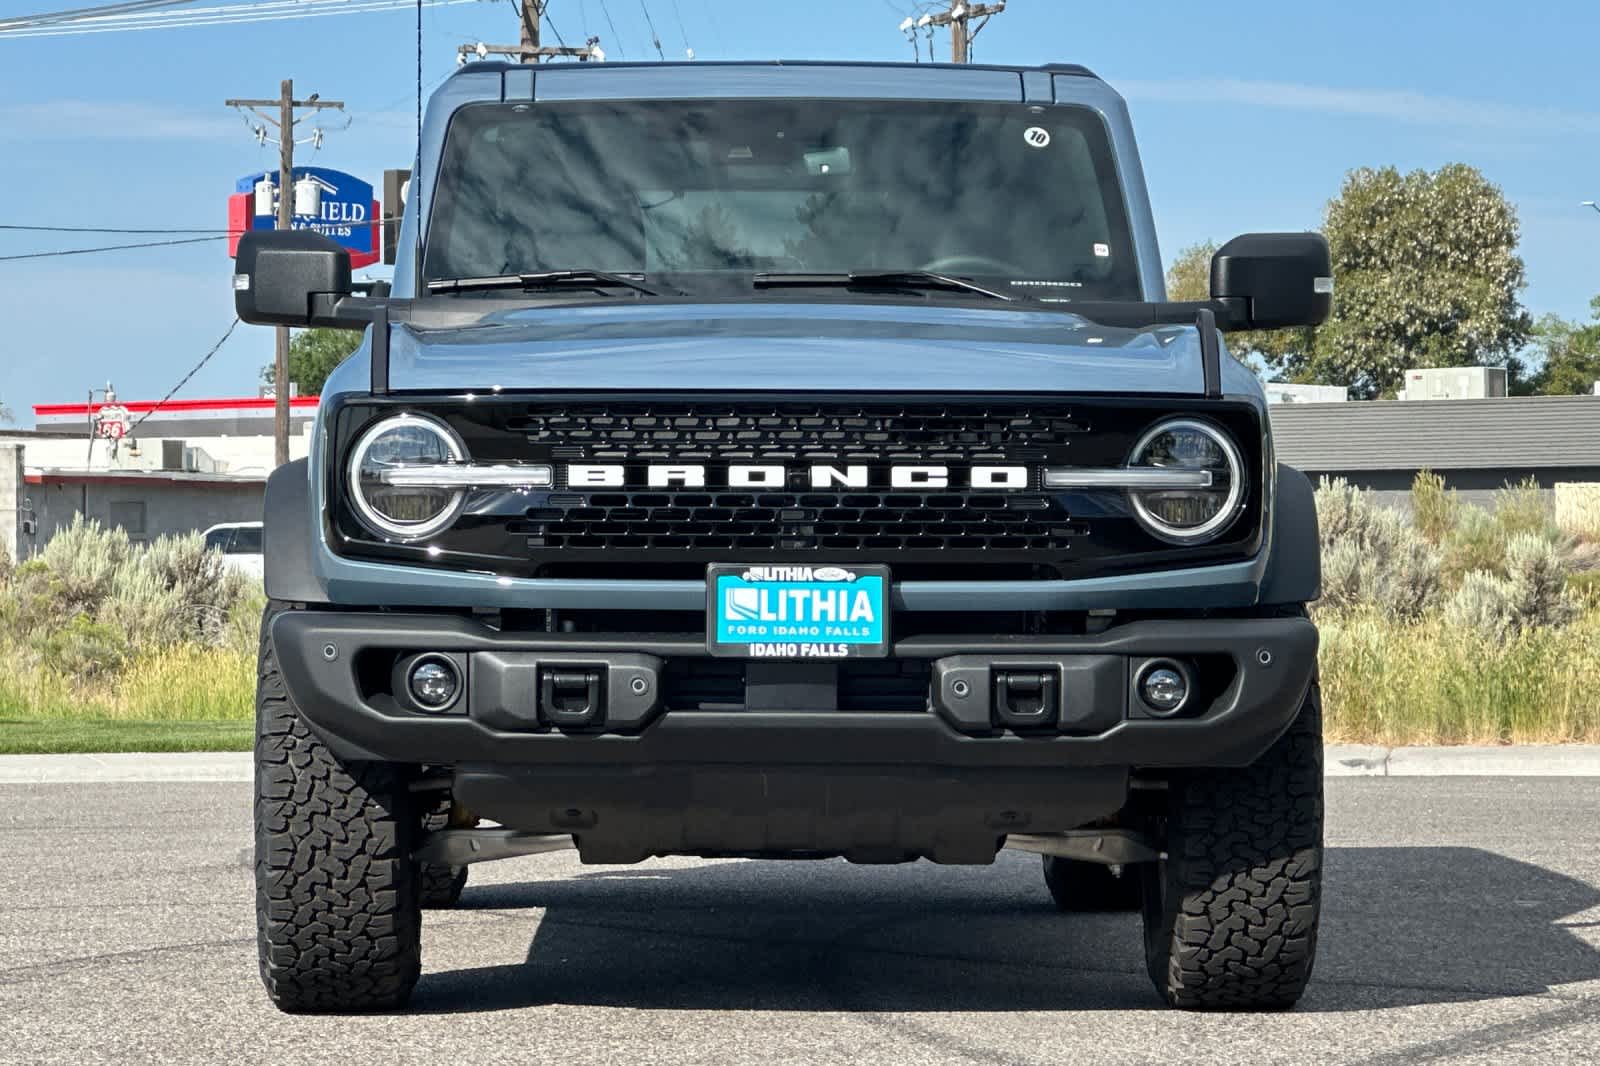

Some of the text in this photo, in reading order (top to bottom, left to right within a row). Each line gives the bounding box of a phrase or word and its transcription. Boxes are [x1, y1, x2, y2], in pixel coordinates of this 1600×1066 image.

[1030, 130, 1047, 145] 10
[103, 423, 121, 437] 66
[567, 464, 1028, 488] BRONCO
[763, 567, 814, 582] LITHIA
[759, 588, 875, 622] LITHIA
[727, 625, 870, 637] FORD IDAHO FALLS
[750, 643, 849, 657] IDAHO FALLS
